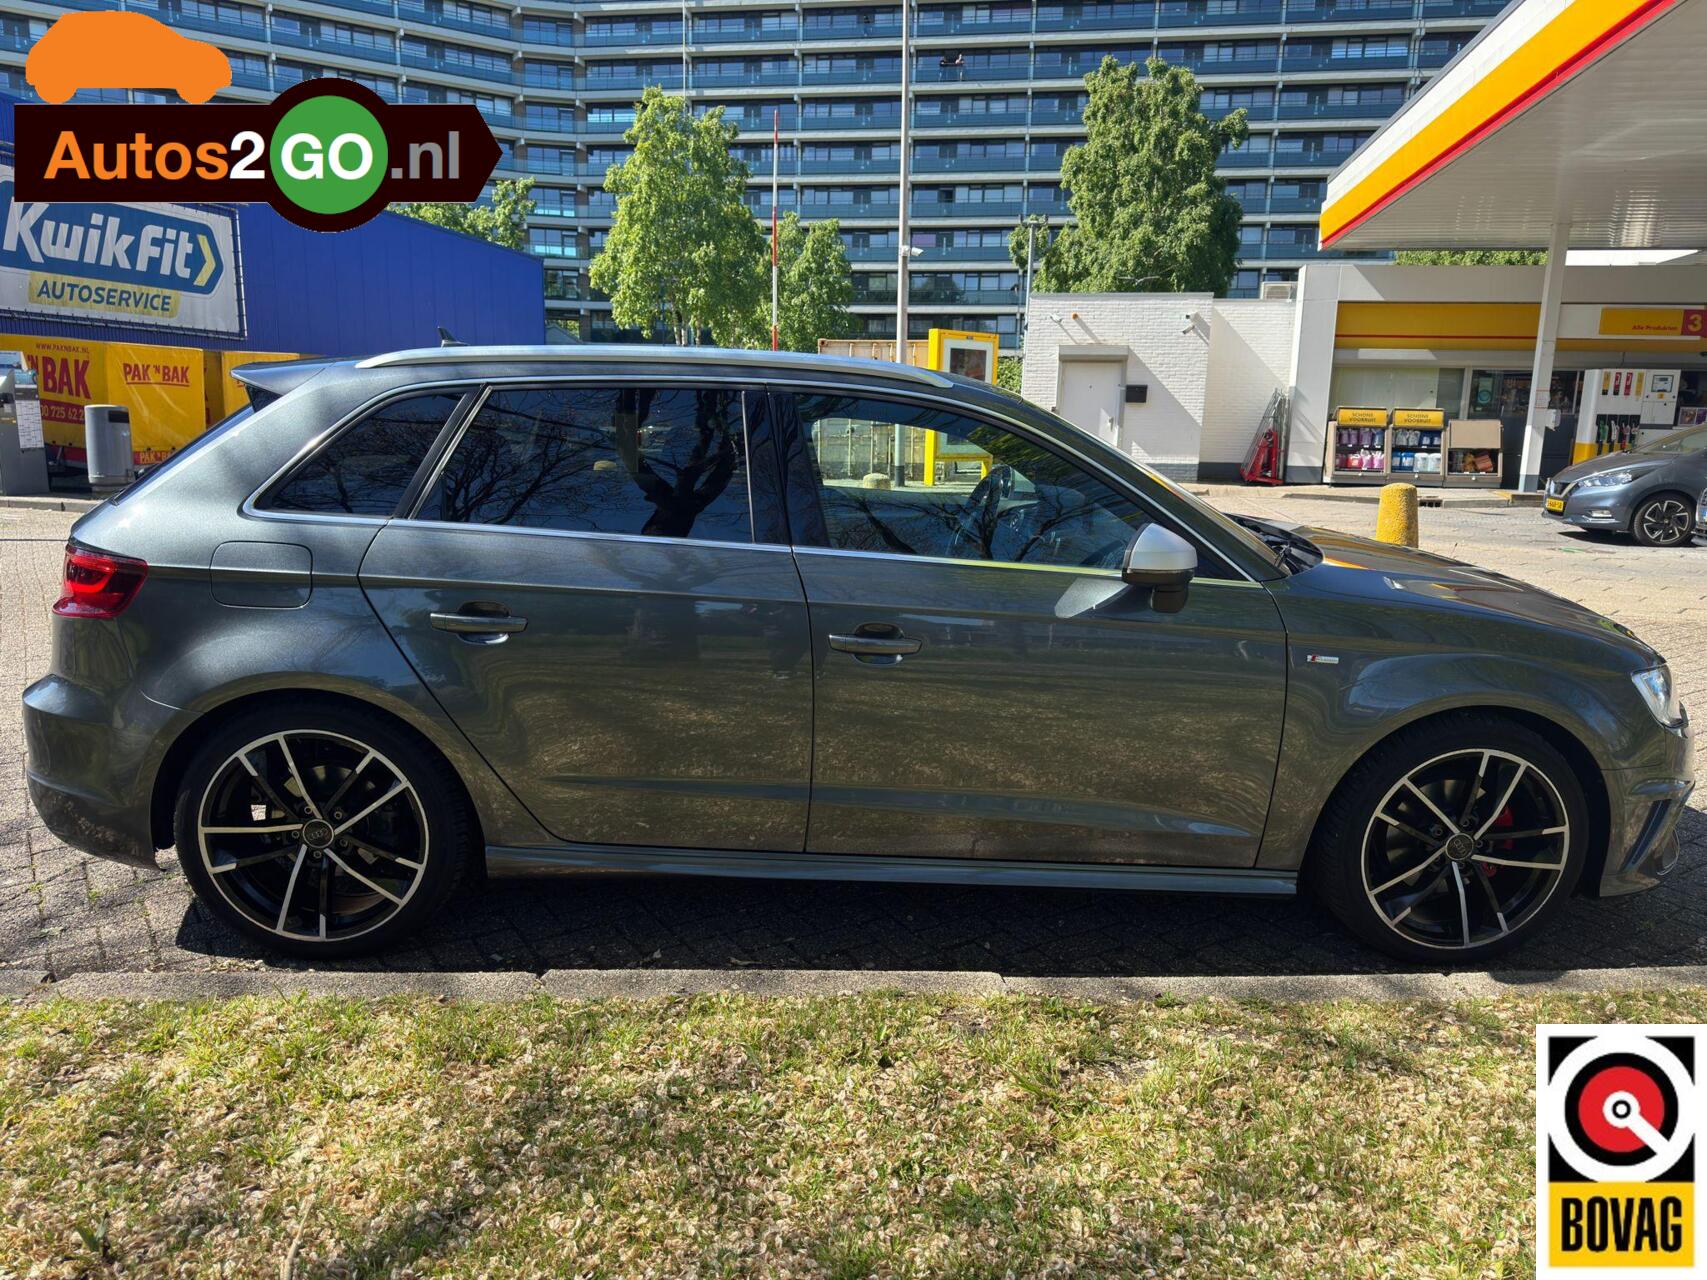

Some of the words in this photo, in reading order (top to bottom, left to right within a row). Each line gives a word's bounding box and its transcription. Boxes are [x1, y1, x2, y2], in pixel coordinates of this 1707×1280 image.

[37, 279, 172, 312] AUTOSERVICE
[1687, 314, 1702, 332] 3
[42, 356, 92, 400] BAK
[123, 363, 152, 381] PAK
[162, 365, 190, 384] BAK
